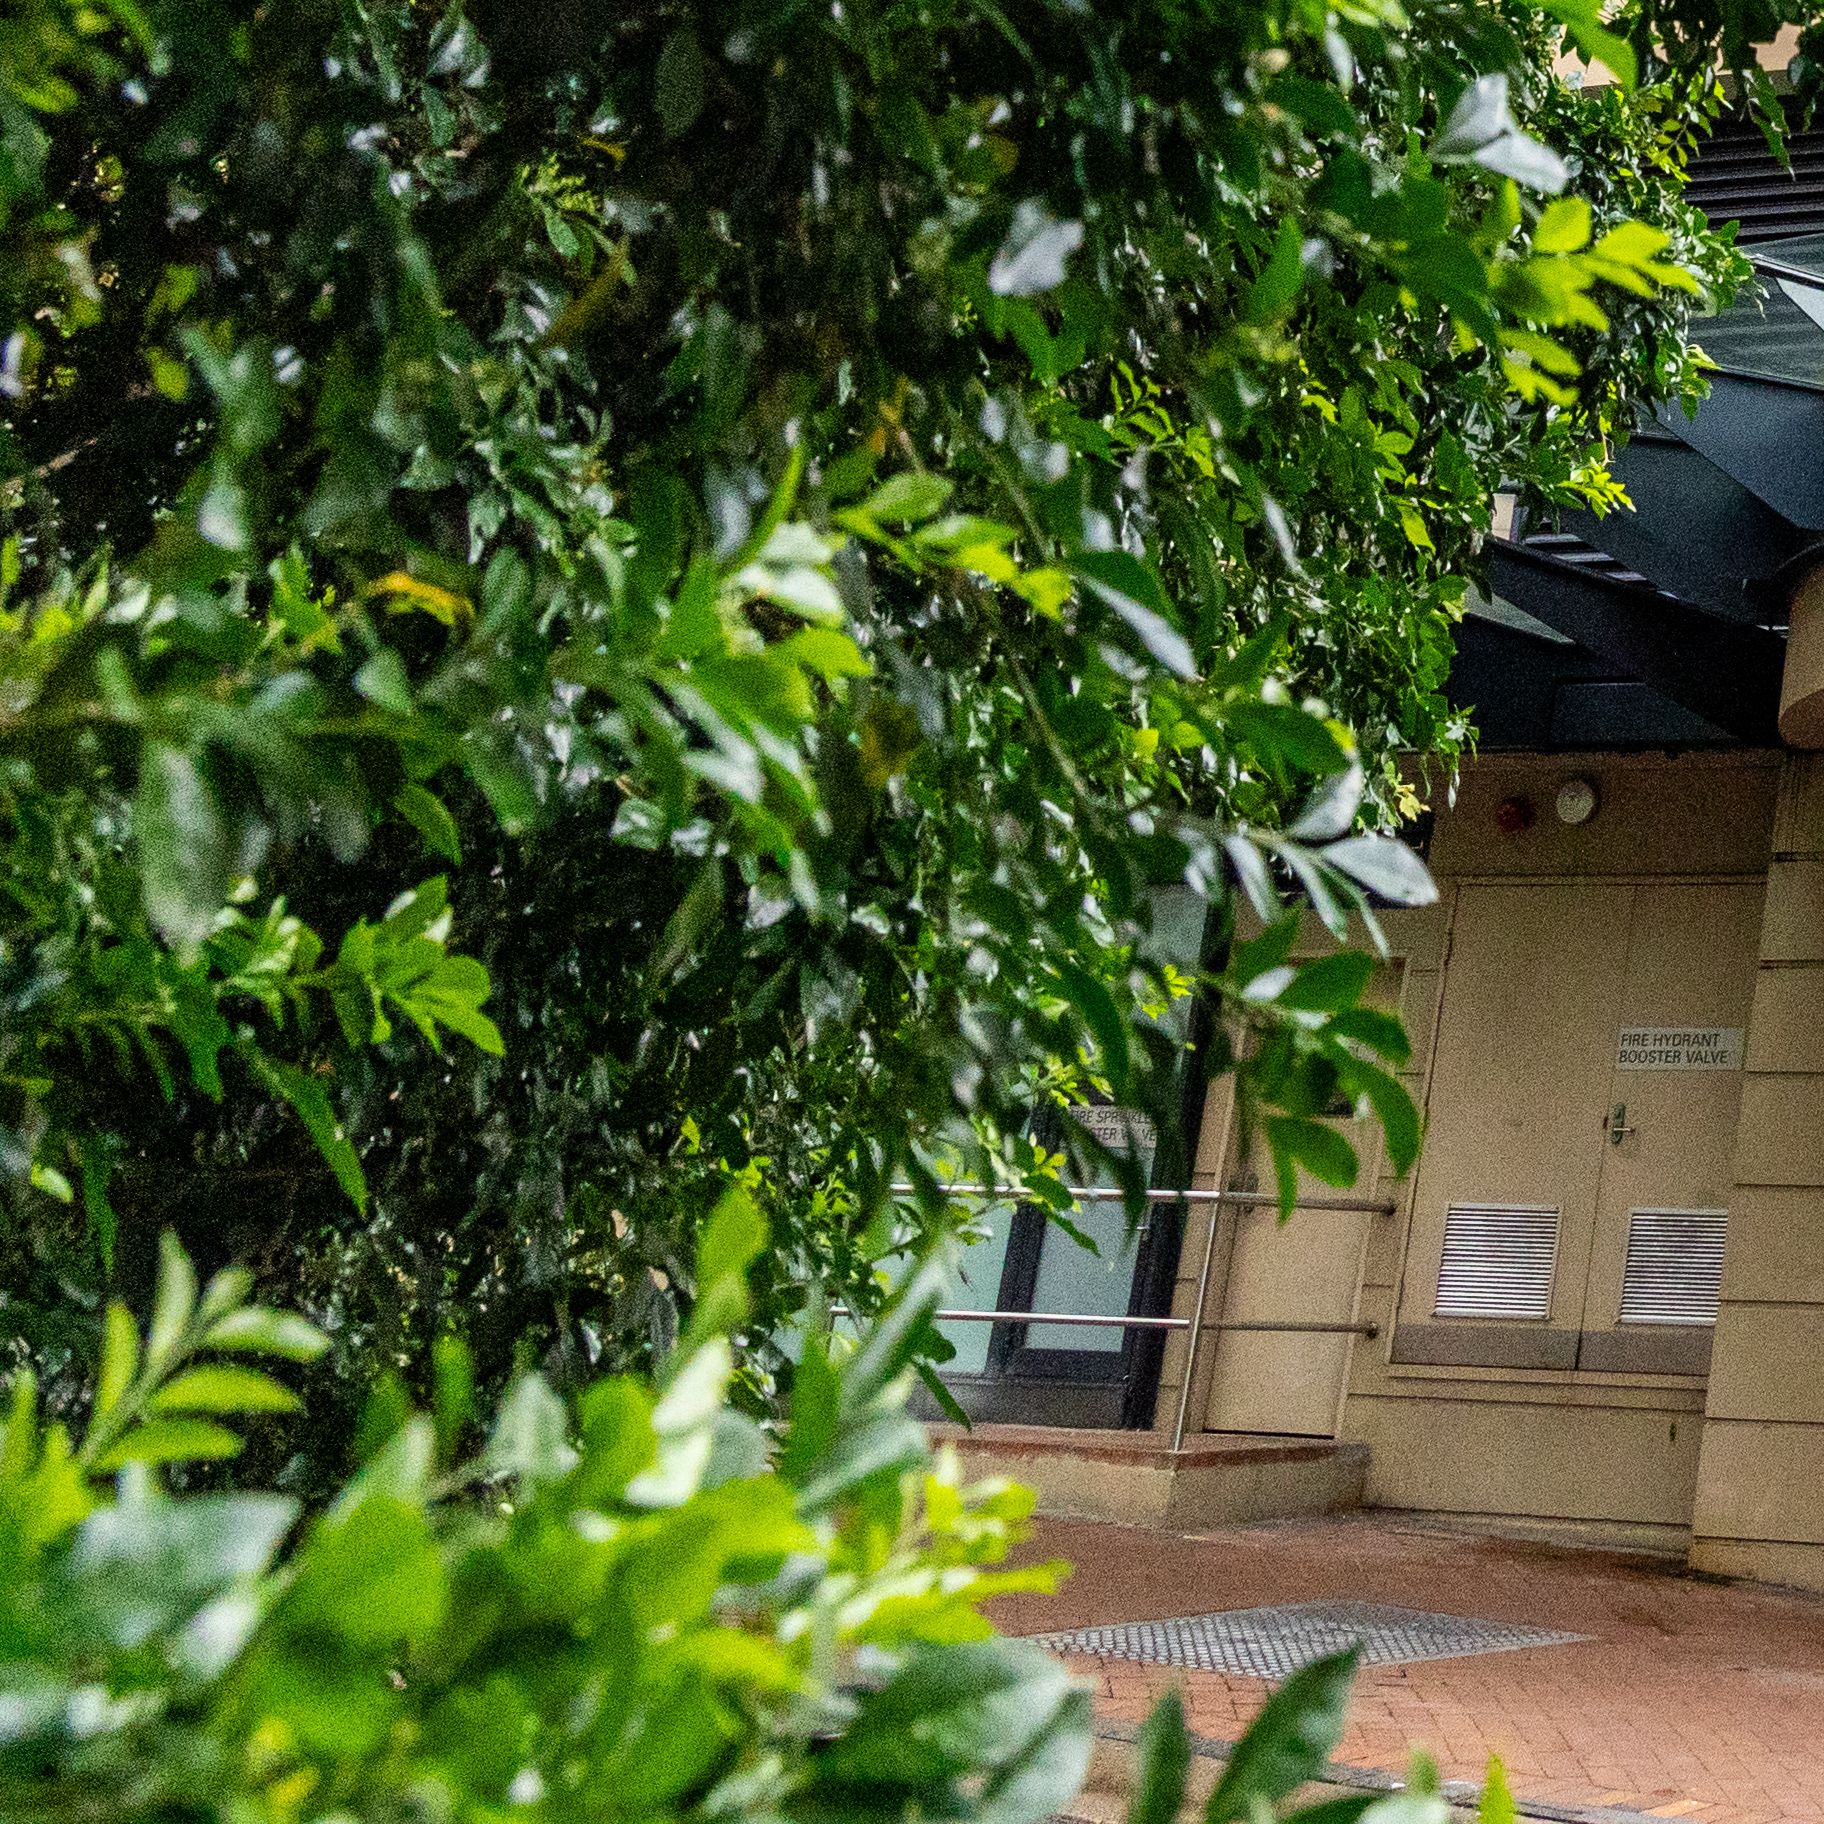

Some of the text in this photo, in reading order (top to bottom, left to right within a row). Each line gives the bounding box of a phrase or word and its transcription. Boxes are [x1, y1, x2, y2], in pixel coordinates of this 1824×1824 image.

[1620, 1033, 1720, 1047] FIRE HYDRANT
[1619, 1049, 1729, 1064] BOOSTER VALVE
